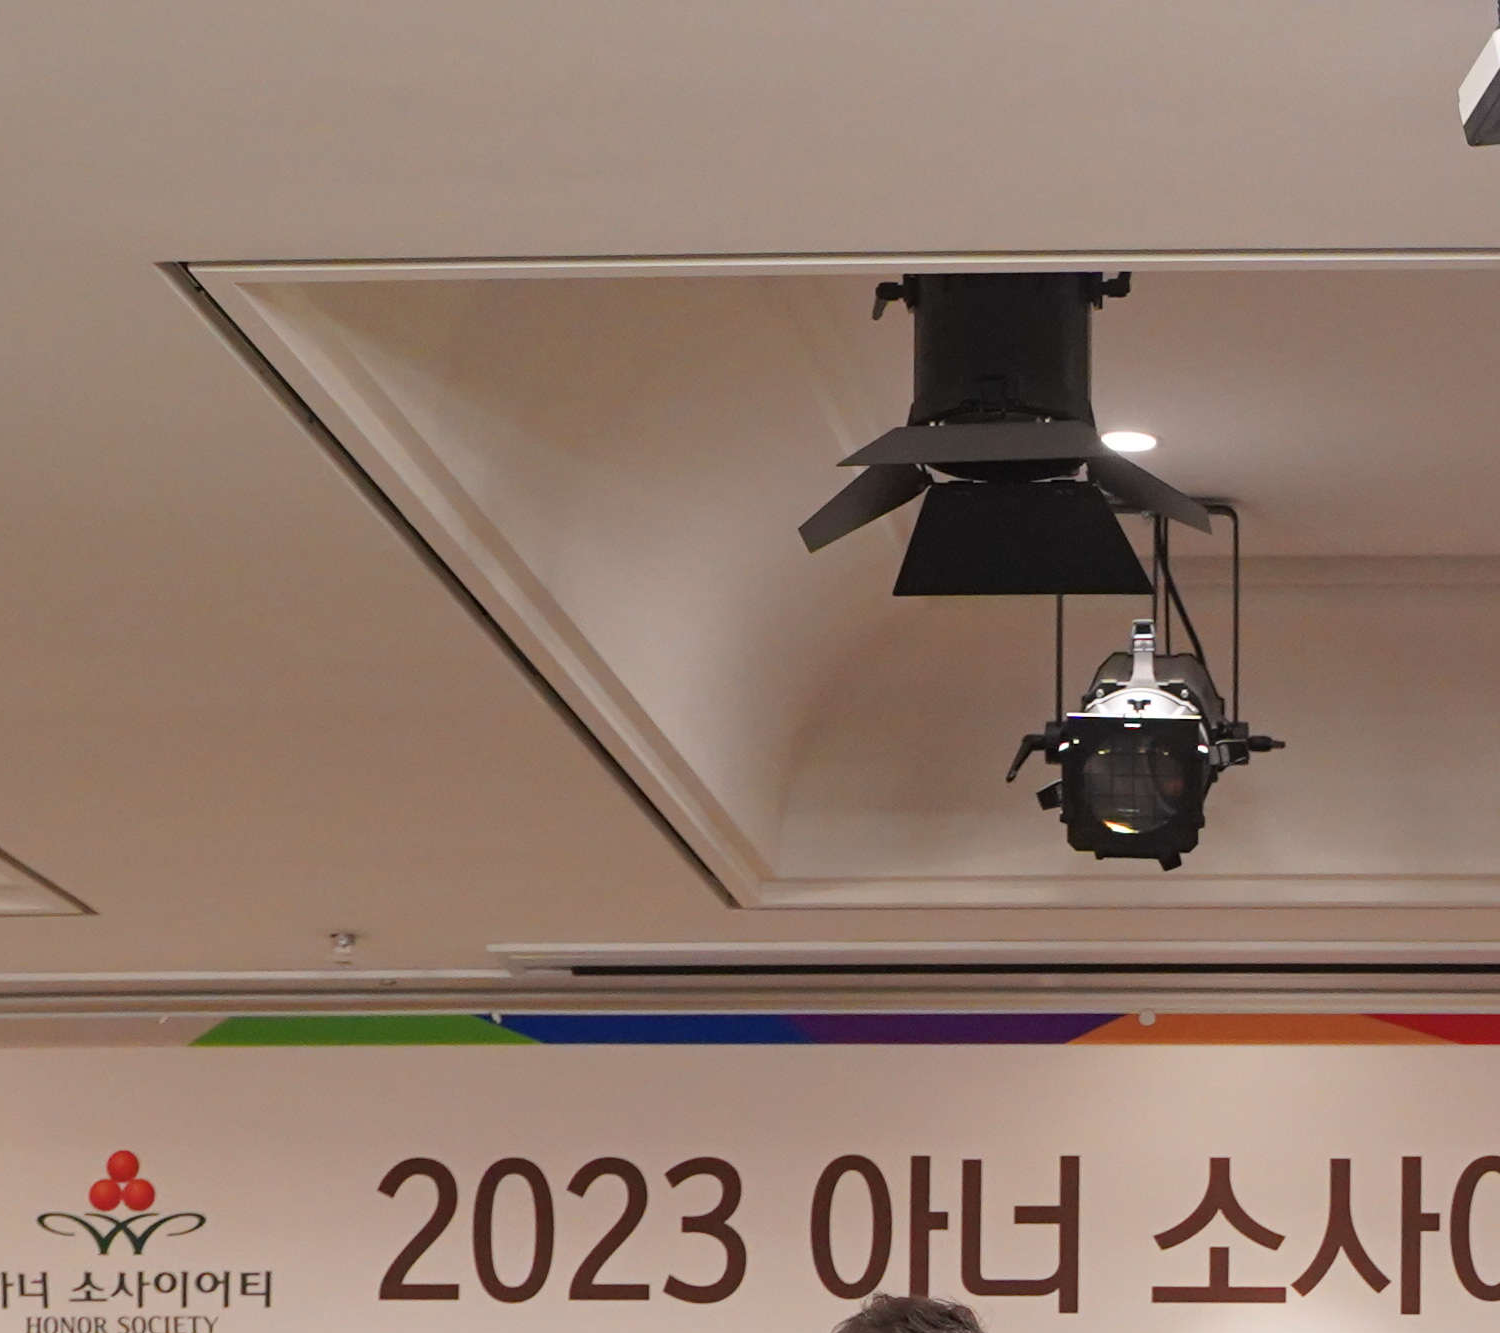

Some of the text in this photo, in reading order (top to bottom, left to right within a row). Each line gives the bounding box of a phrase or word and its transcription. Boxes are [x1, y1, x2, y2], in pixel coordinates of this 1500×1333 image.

[378, 1157, 747, 1303] 2023
[811, 1154, 1081, 1314] 아너
[69, 1270, 272, 1309] 소사이어티
